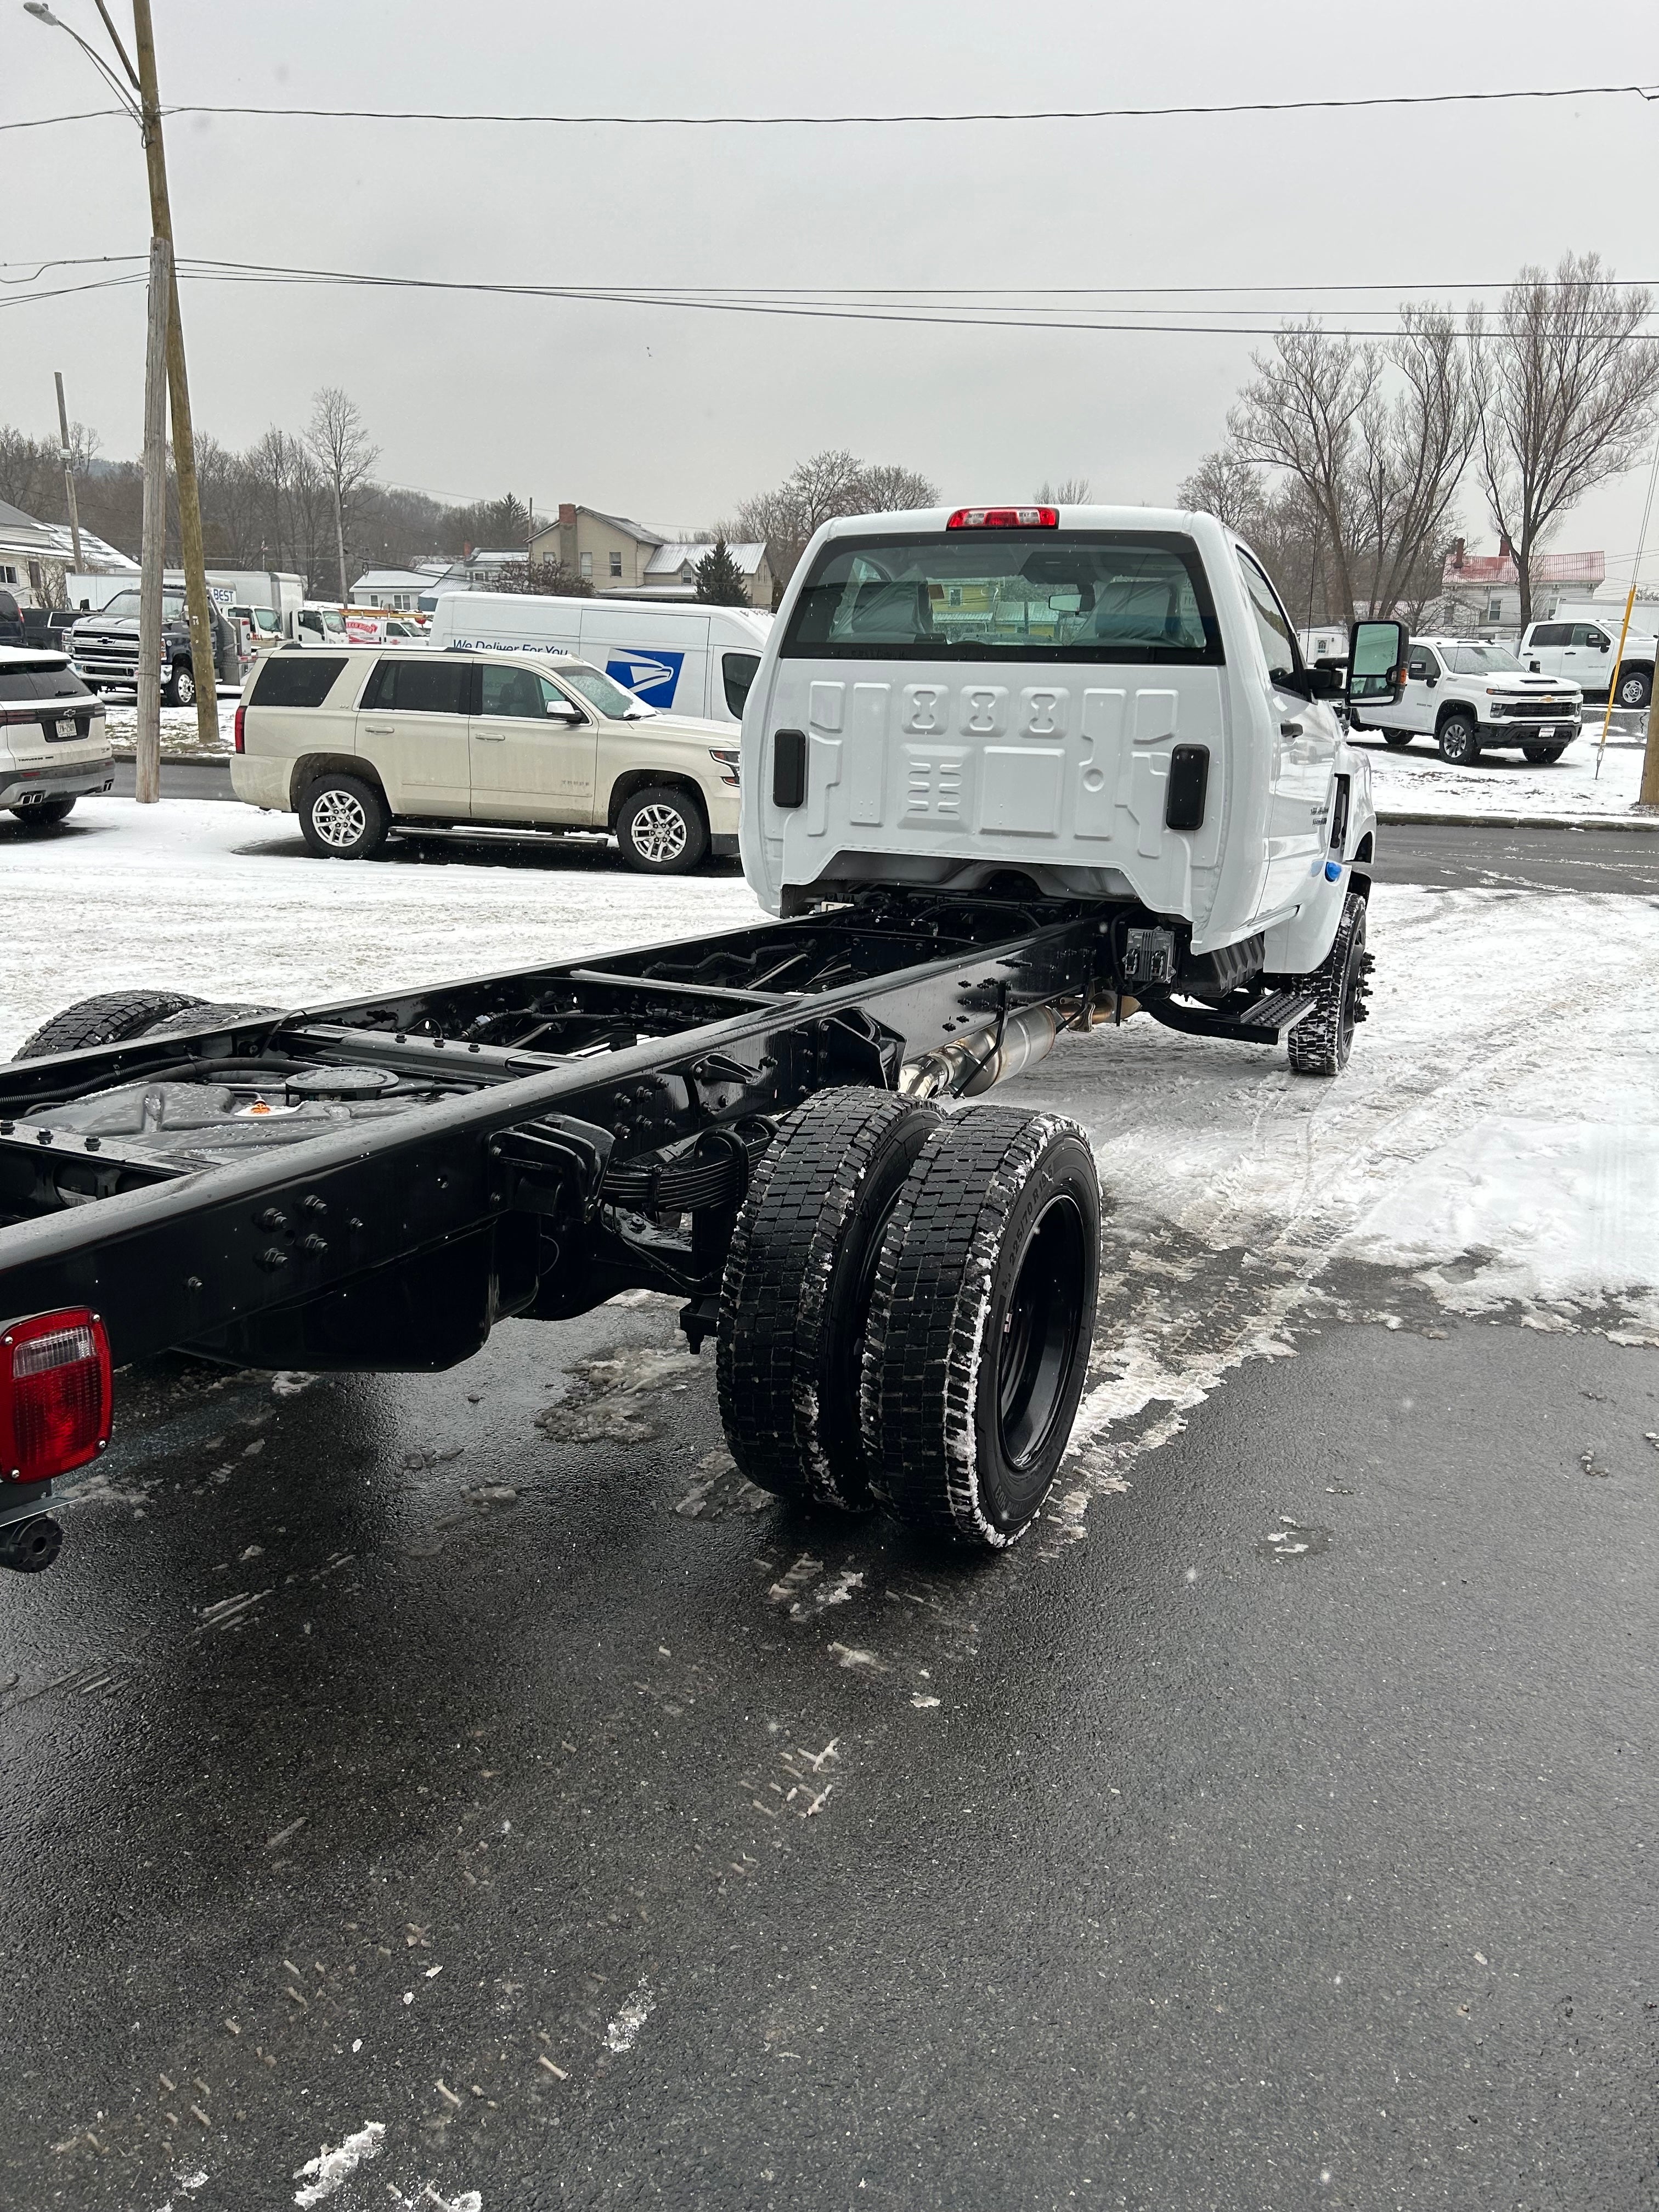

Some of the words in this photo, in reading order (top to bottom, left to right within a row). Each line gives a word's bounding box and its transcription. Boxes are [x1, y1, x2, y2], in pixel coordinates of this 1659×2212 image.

[213, 589, 234, 602] BEST
[545, 645, 568, 655] You
[1009, 1201, 1032, 1267] 225/70
